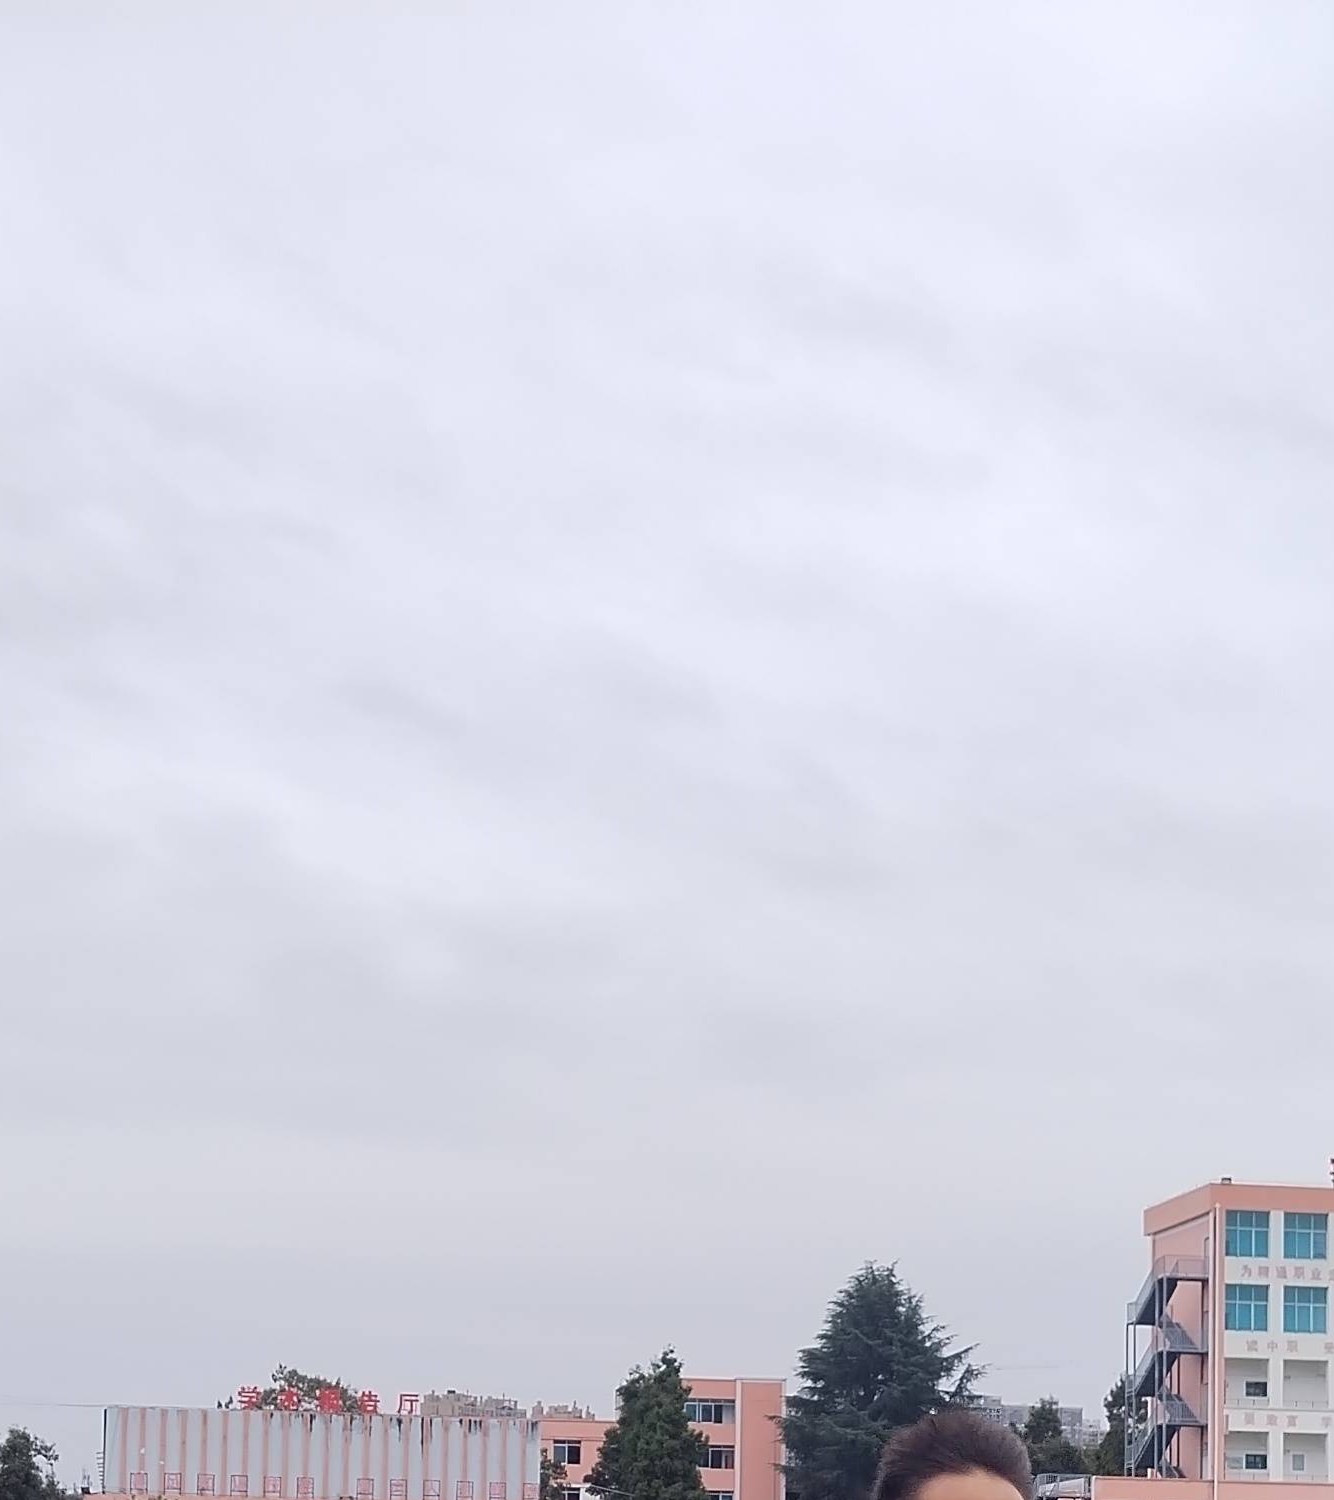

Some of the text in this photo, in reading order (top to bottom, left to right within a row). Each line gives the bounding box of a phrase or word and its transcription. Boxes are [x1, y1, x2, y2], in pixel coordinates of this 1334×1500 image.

[238, 1386, 419, 1416] 学术报告厅
